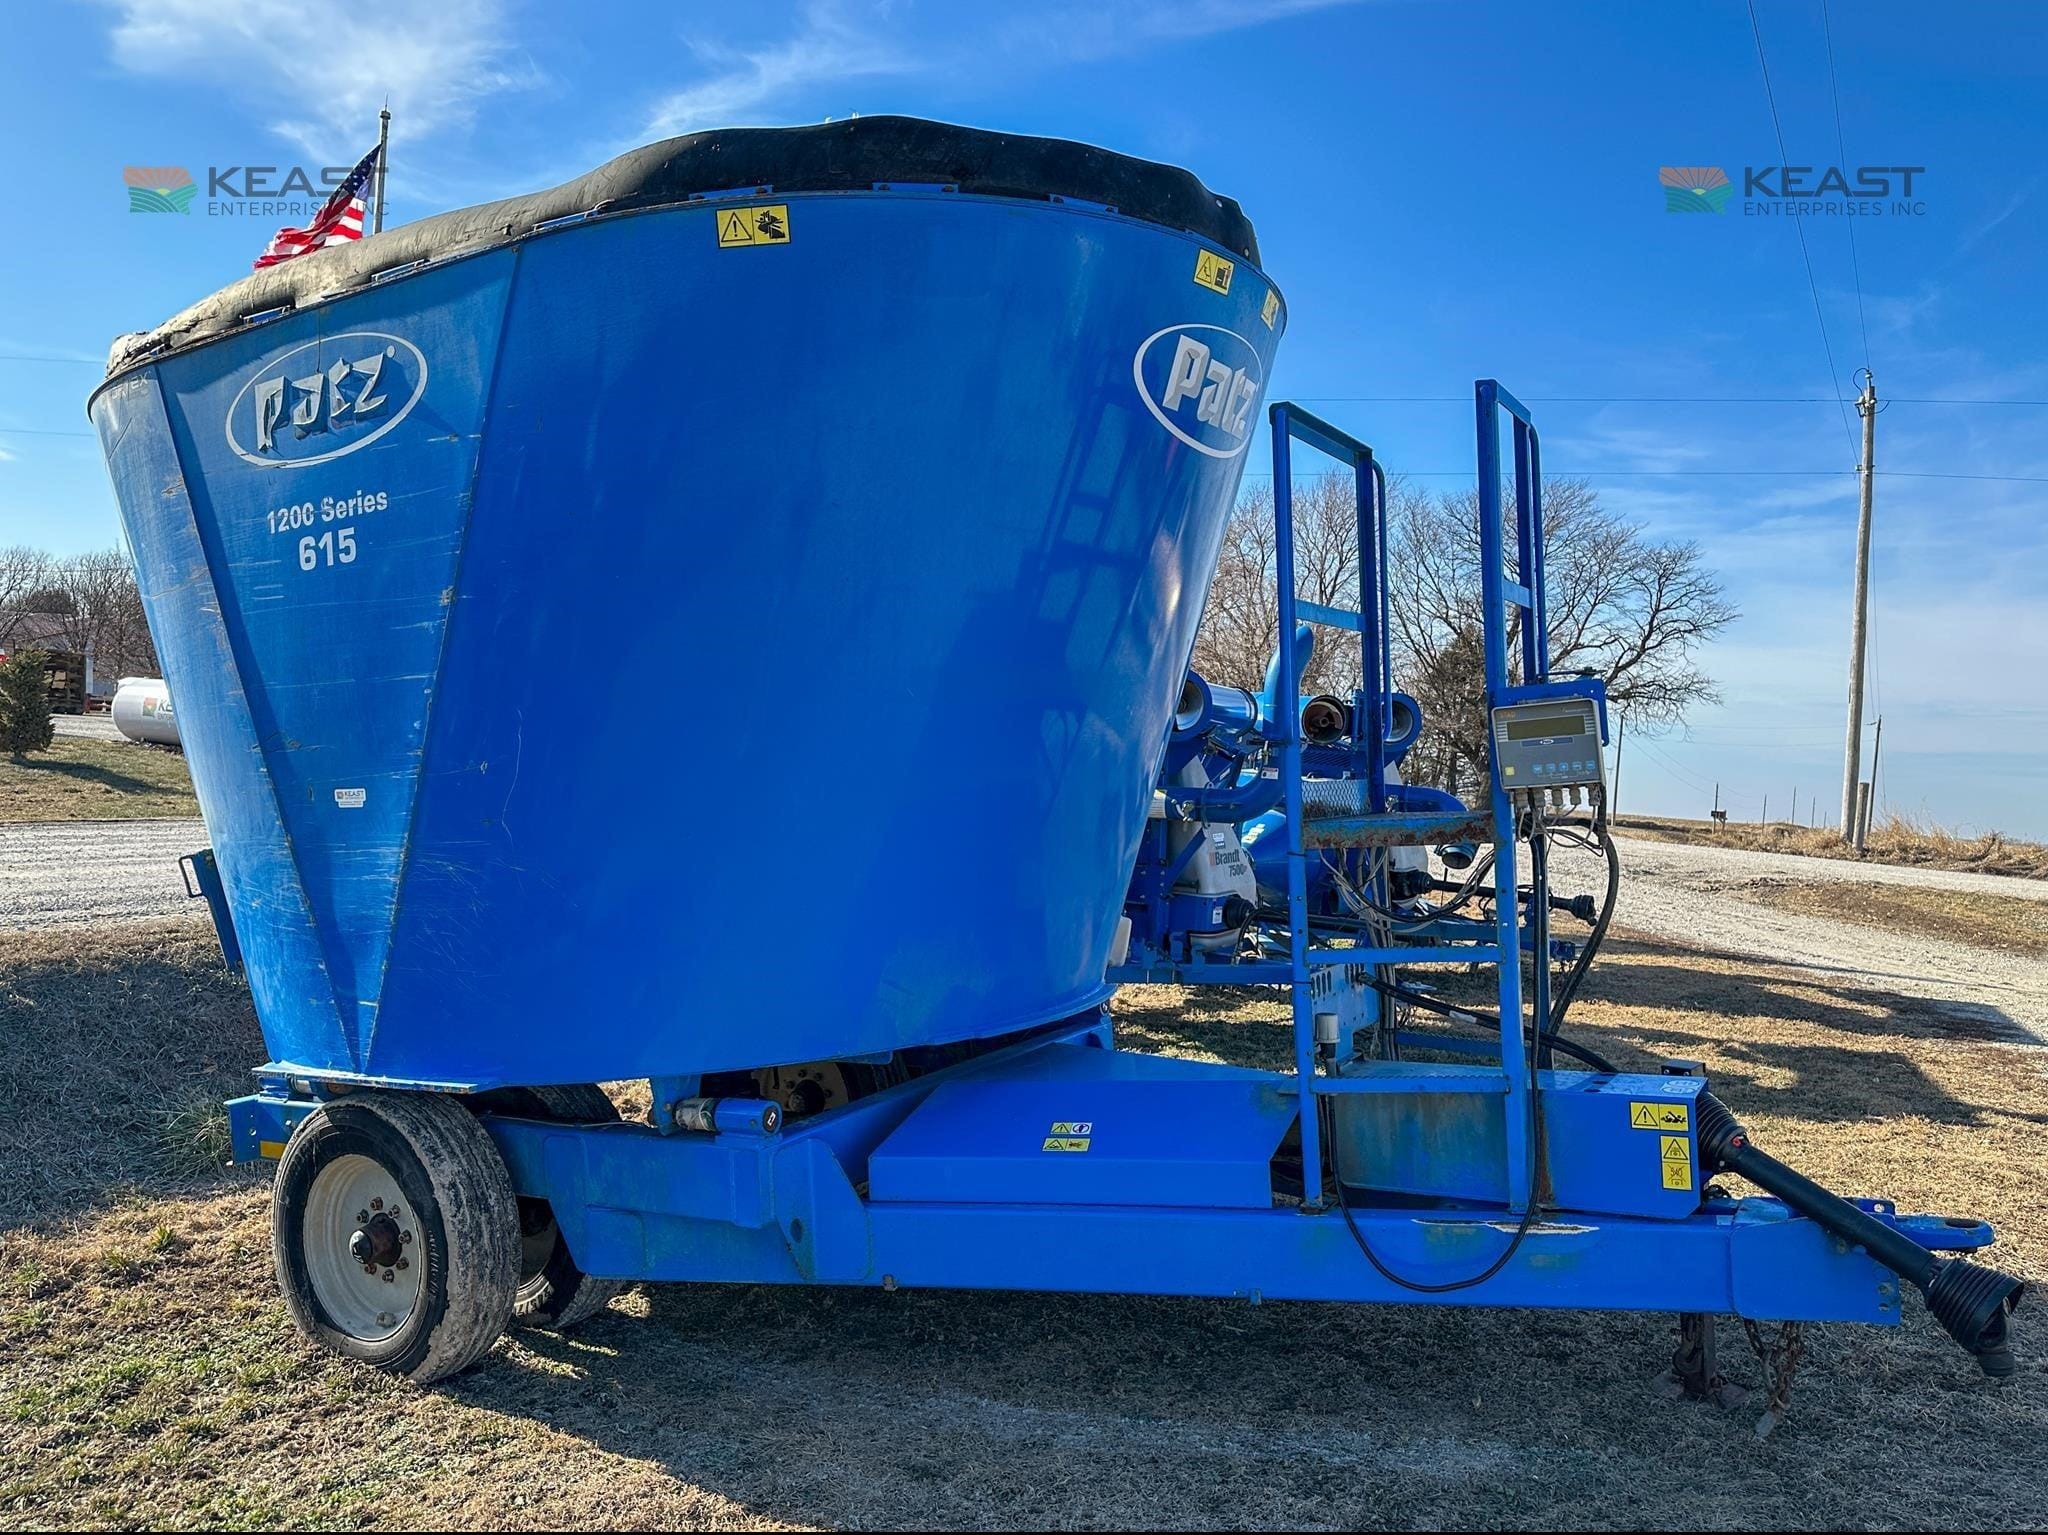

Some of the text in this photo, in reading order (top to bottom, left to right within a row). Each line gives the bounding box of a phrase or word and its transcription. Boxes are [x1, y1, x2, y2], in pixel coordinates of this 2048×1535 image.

[1162, 334, 1258, 440] Patz
[267, 490, 388, 534] 1200 Series
[299, 527, 357, 571] 615
